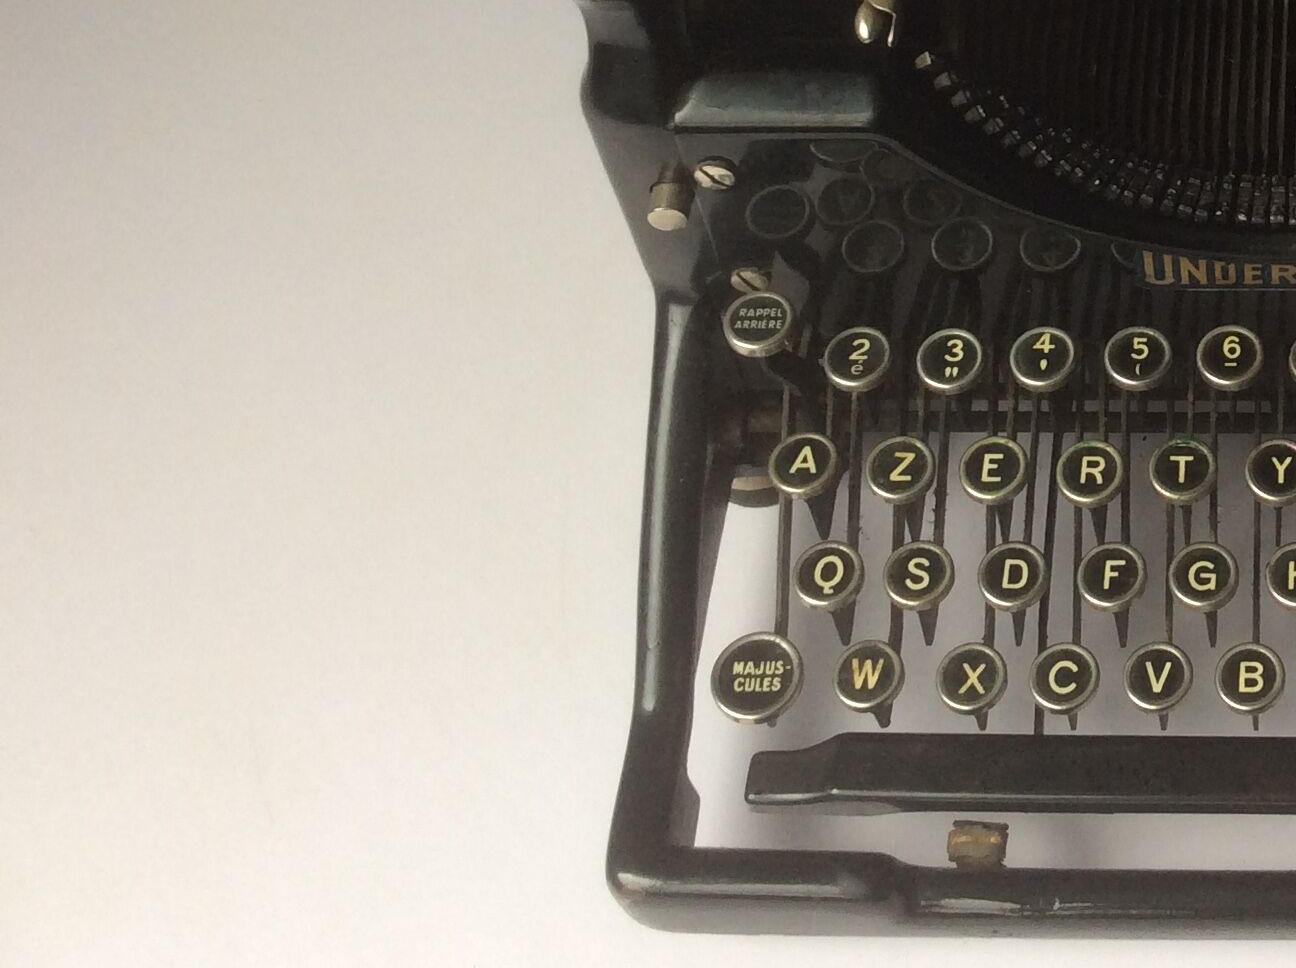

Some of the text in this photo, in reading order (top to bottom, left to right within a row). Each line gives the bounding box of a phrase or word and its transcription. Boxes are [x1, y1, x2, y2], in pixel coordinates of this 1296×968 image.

[739, 307, 783, 318] RAPPEL
[849, 338, 870, 360] 2
[944, 338, 965, 362] 3
[1032, 332, 1056, 354] 4
[1130, 336, 1149, 360] 5
[1222, 335, 1241, 359] 6
[789, 445, 817, 474] A
[889, 451, 916, 482] Z
[980, 453, 1004, 483] E
[1079, 455, 1106, 485] R
[1169, 455, 1194, 484] T
[1271, 456, 1293, 484] Y
[813, 554, 845, 594] Q
[905, 557, 930, 591] S
[1001, 558, 1029, 589] D
[1103, 559, 1126, 590] F
[1187, 560, 1217, 591] G
[733, 676, 782, 693] CULES
[851, 658, 884, 690] W
[958, 662, 986, 695] X
[1048, 660, 1079, 695] C
[1145, 661, 1172, 693] V
[1238, 661, 1264, 693] B
